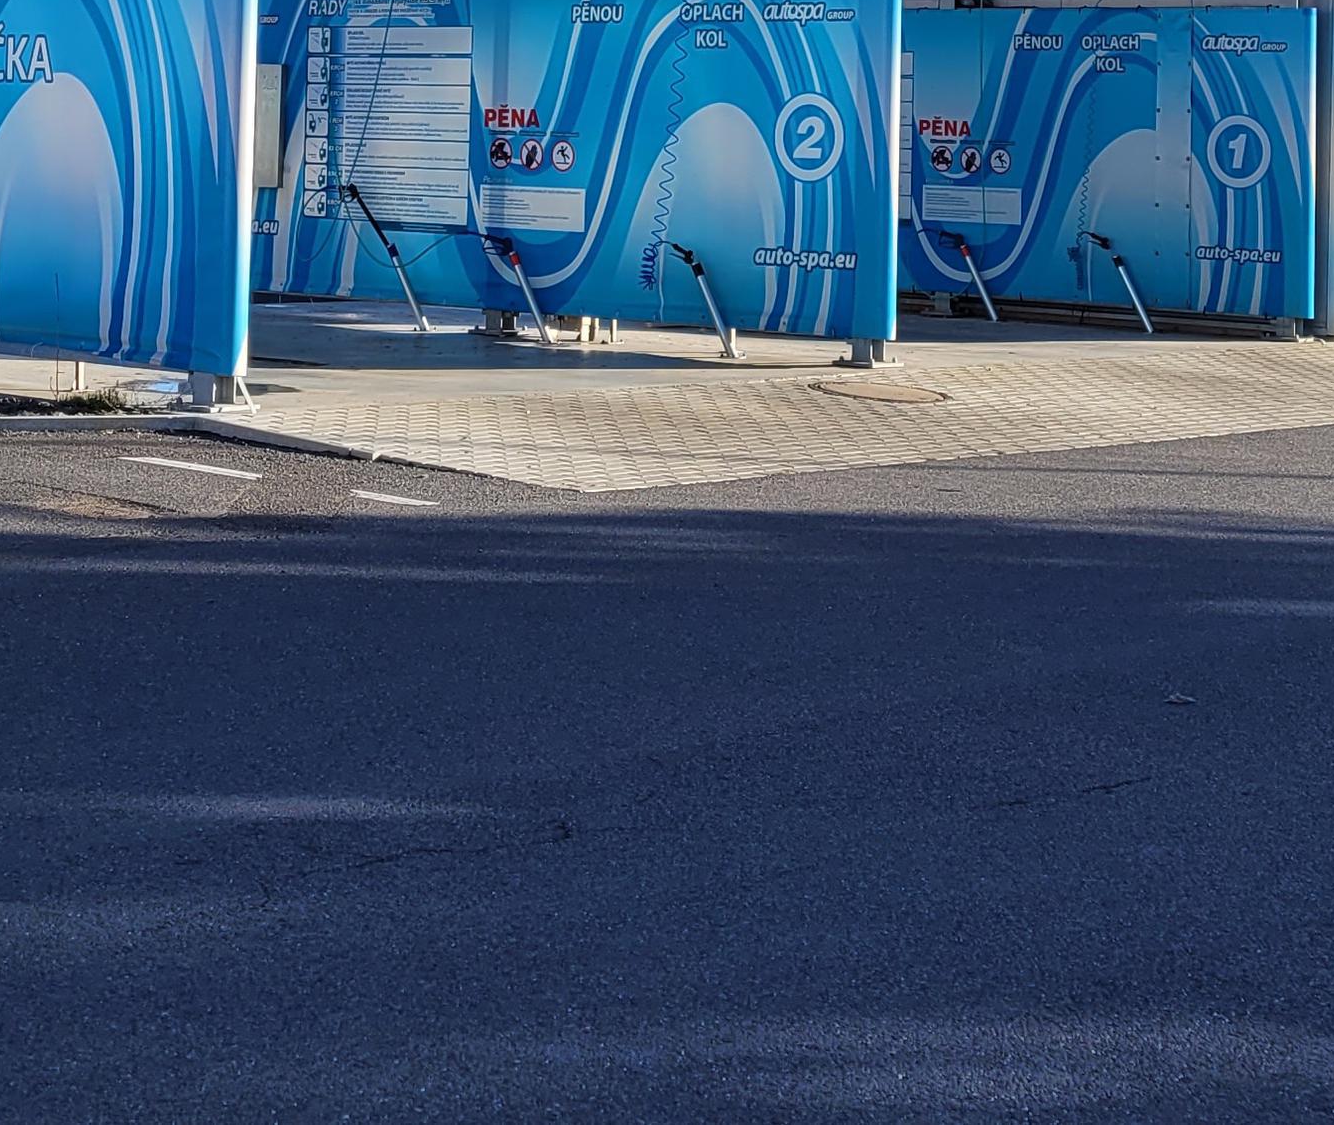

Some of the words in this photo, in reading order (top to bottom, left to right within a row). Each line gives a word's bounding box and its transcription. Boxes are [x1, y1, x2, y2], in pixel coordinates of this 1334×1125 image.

[309, 0, 347, 16] RADY
[572, 2, 623, 21] PĚNOU
[681, 4, 744, 21] OPLACH
[764, 2, 824, 24] autospa
[827, 10, 854, 20] GROUP
[696, 31, 727, 47] KOL
[1015, 32, 1062, 49] PĚNOU
[1082, 35, 1140, 50] OPLACH
[1202, 35, 1258, 55] autospa
[1261, 43, 1286, 51] GROUP
[1097, 57, 1124, 71] KOL
[484, 104, 540, 128] PĚNA
[919, 116, 971, 137] PĚNA
[793, 116, 826, 159] 2
[1228, 133, 1247, 169] 1
[755, 247, 856, 271] auto-spa.eu
[1197, 246, 1280, 263] auto-spa.eu
